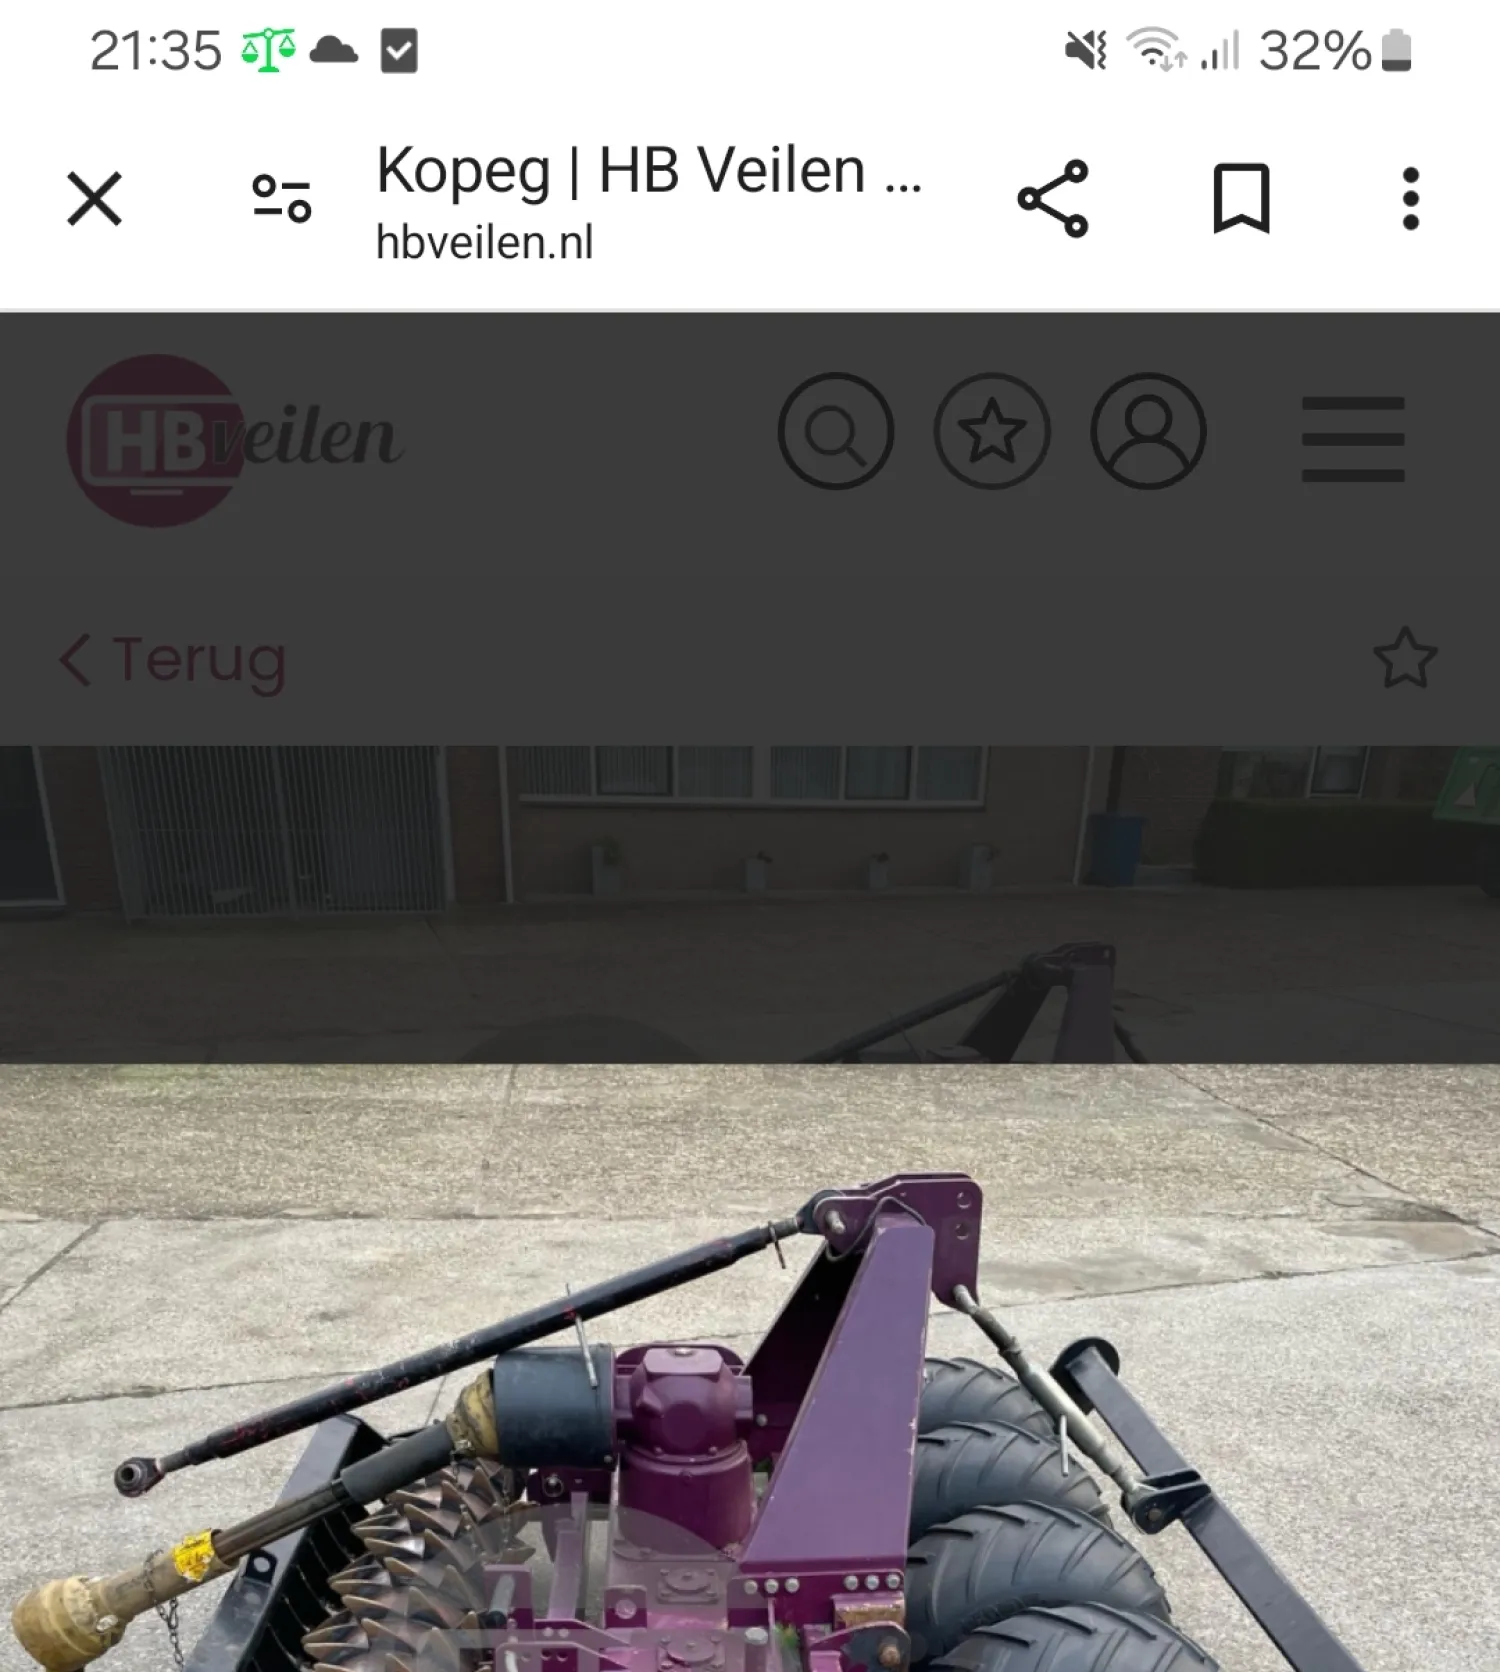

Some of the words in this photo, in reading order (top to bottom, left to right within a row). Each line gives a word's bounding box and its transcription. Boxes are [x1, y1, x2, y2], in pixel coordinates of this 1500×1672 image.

[91, 29, 222, 71] 21:35
[1259, 29, 1373, 71] 32%
[379, 145, 549, 206] Kopeg
[602, 145, 679, 193] HB
[696, 142, 864, 193] Veilen
[377, 222, 593, 260] hbveilen.nl
[106, 410, 206, 472] HB
[211, 403, 406, 465] veilen
[112, 636, 286, 698] Terug
